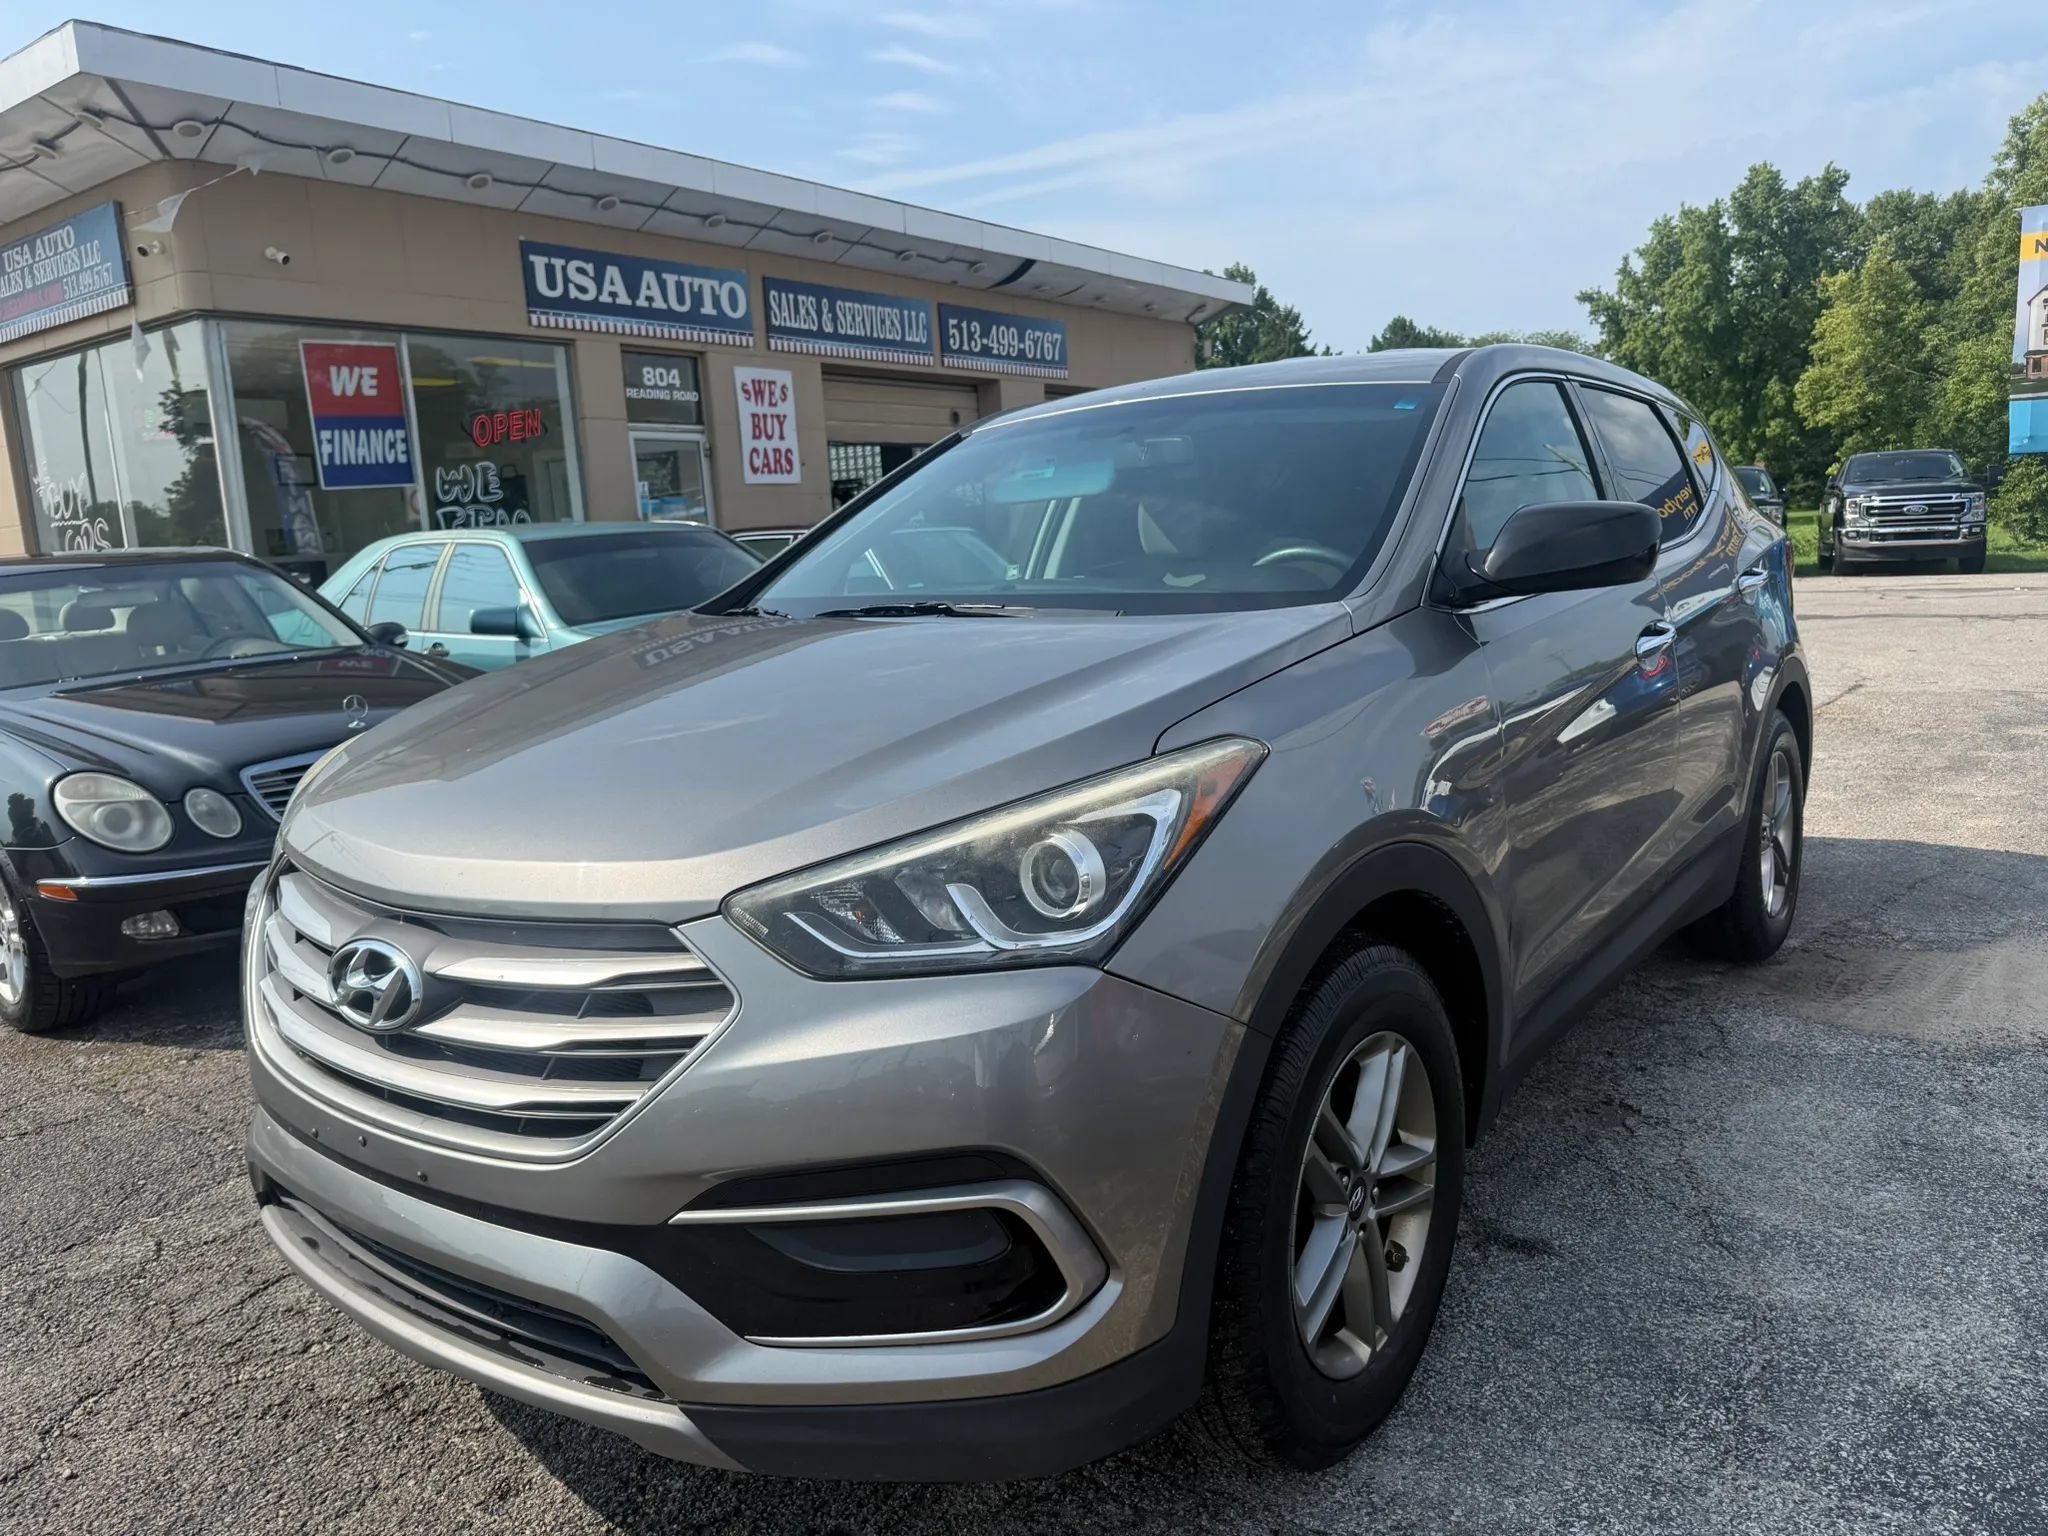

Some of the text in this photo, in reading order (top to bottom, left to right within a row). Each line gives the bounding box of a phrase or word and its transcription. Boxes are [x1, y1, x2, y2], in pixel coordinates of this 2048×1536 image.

[2, 224, 76, 273] USA AUTO
[0, 239, 101, 298] ALES & SERVICES LLC
[529, 254, 747, 319] USA AUTO
[769, 290, 928, 344] SALES & SERVICES LLC
[948, 318, 1062, 361] 513-499-6767
[329, 365, 379, 397] WE
[626, 388, 699, 402] READING ROAD
[642, 367, 681, 388] 804
[473, 408, 542, 447] OPEN
[750, 412, 787, 441] BUY
[319, 428, 408, 467] FINANCE
[749, 446, 793, 475] CARS
[436, 461, 504, 503] WE
